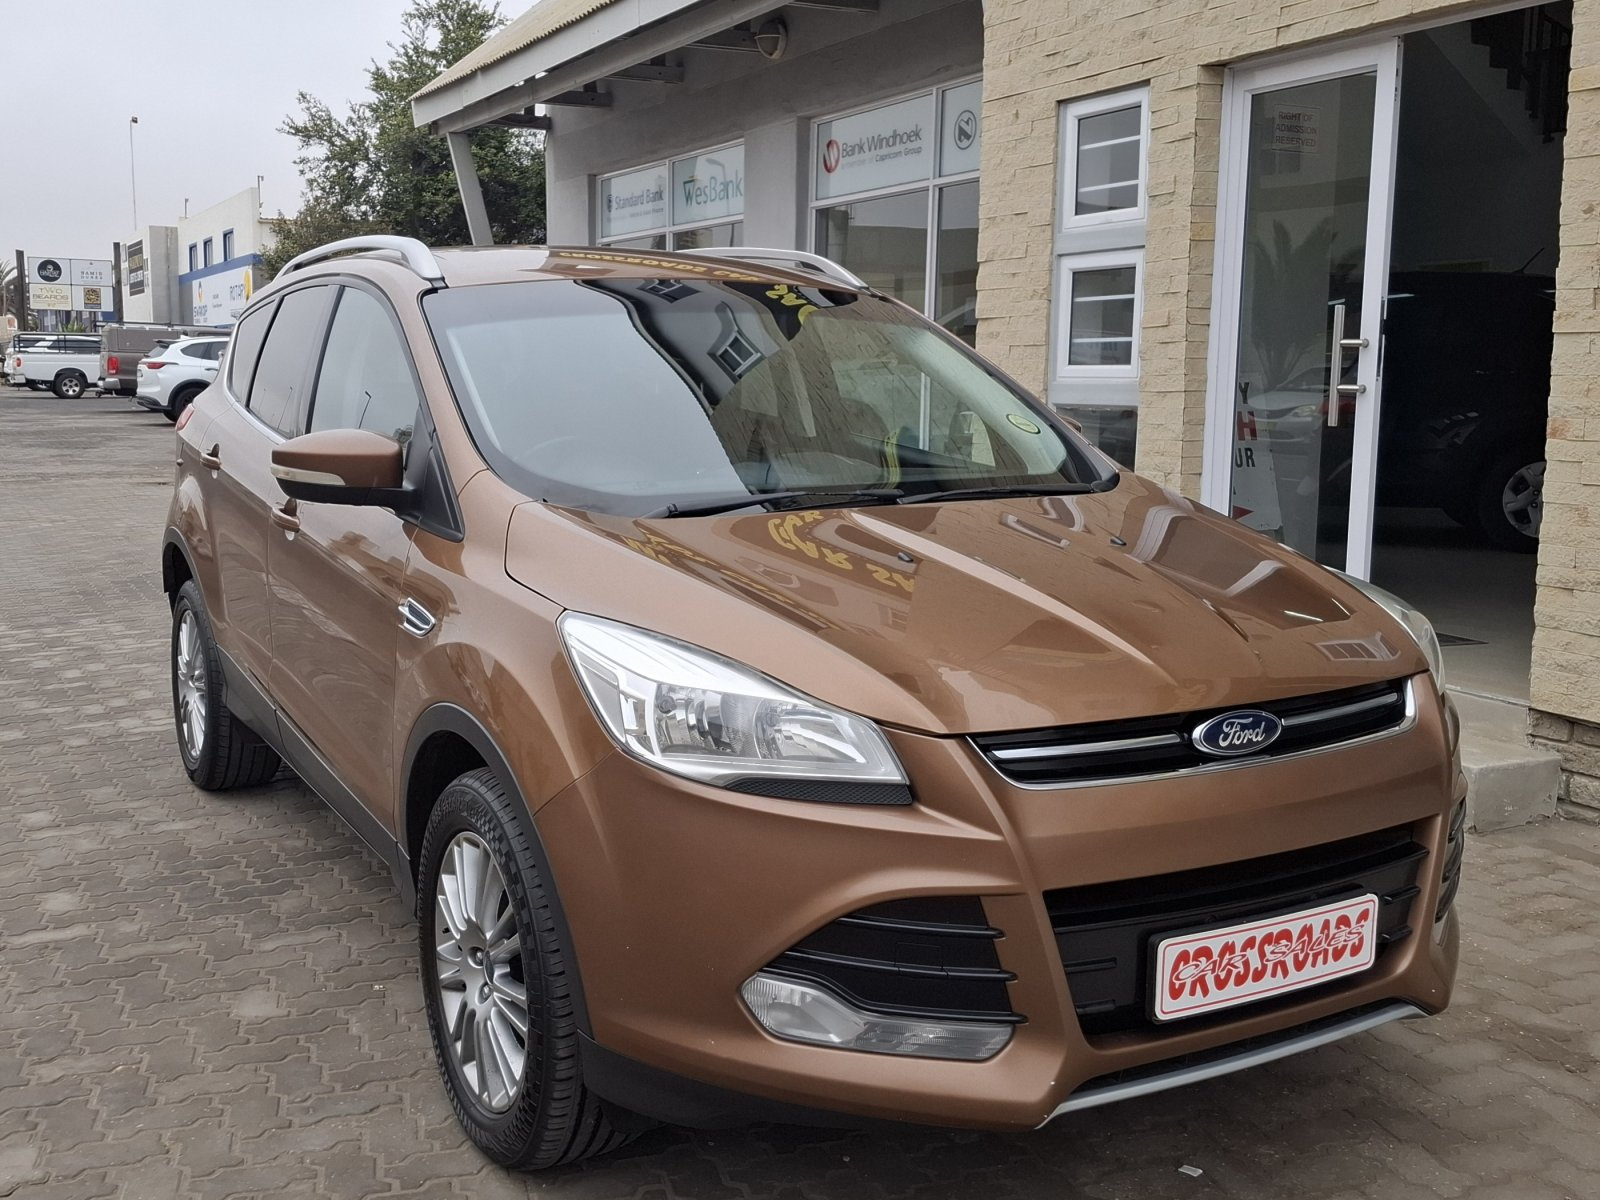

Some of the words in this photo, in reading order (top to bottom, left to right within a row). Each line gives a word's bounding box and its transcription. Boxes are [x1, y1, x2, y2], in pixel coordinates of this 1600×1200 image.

[1275, 123, 1317, 135] ADMISSION
[1278, 111, 1301, 121] RIGHT
[1302, 112, 1314, 122] OF
[841, 137, 866, 158] Bank
[866, 124, 922, 152] Windhoek
[1275, 135, 1316, 147] RESERVED
[614, 190, 644, 210] Standard
[645, 185, 664, 204] Bank
[683, 170, 744, 207] WesBank
[1238, 382, 1250, 404] Y
[1236, 411, 1257, 441] H
[1235, 447, 1256, 468] UR
[1218, 717, 1266, 747] Ford
[1168, 907, 1370, 1001] CROSSROADS
[1173, 951, 1247, 983] CAR
[1263, 923, 1366, 965] SALES
